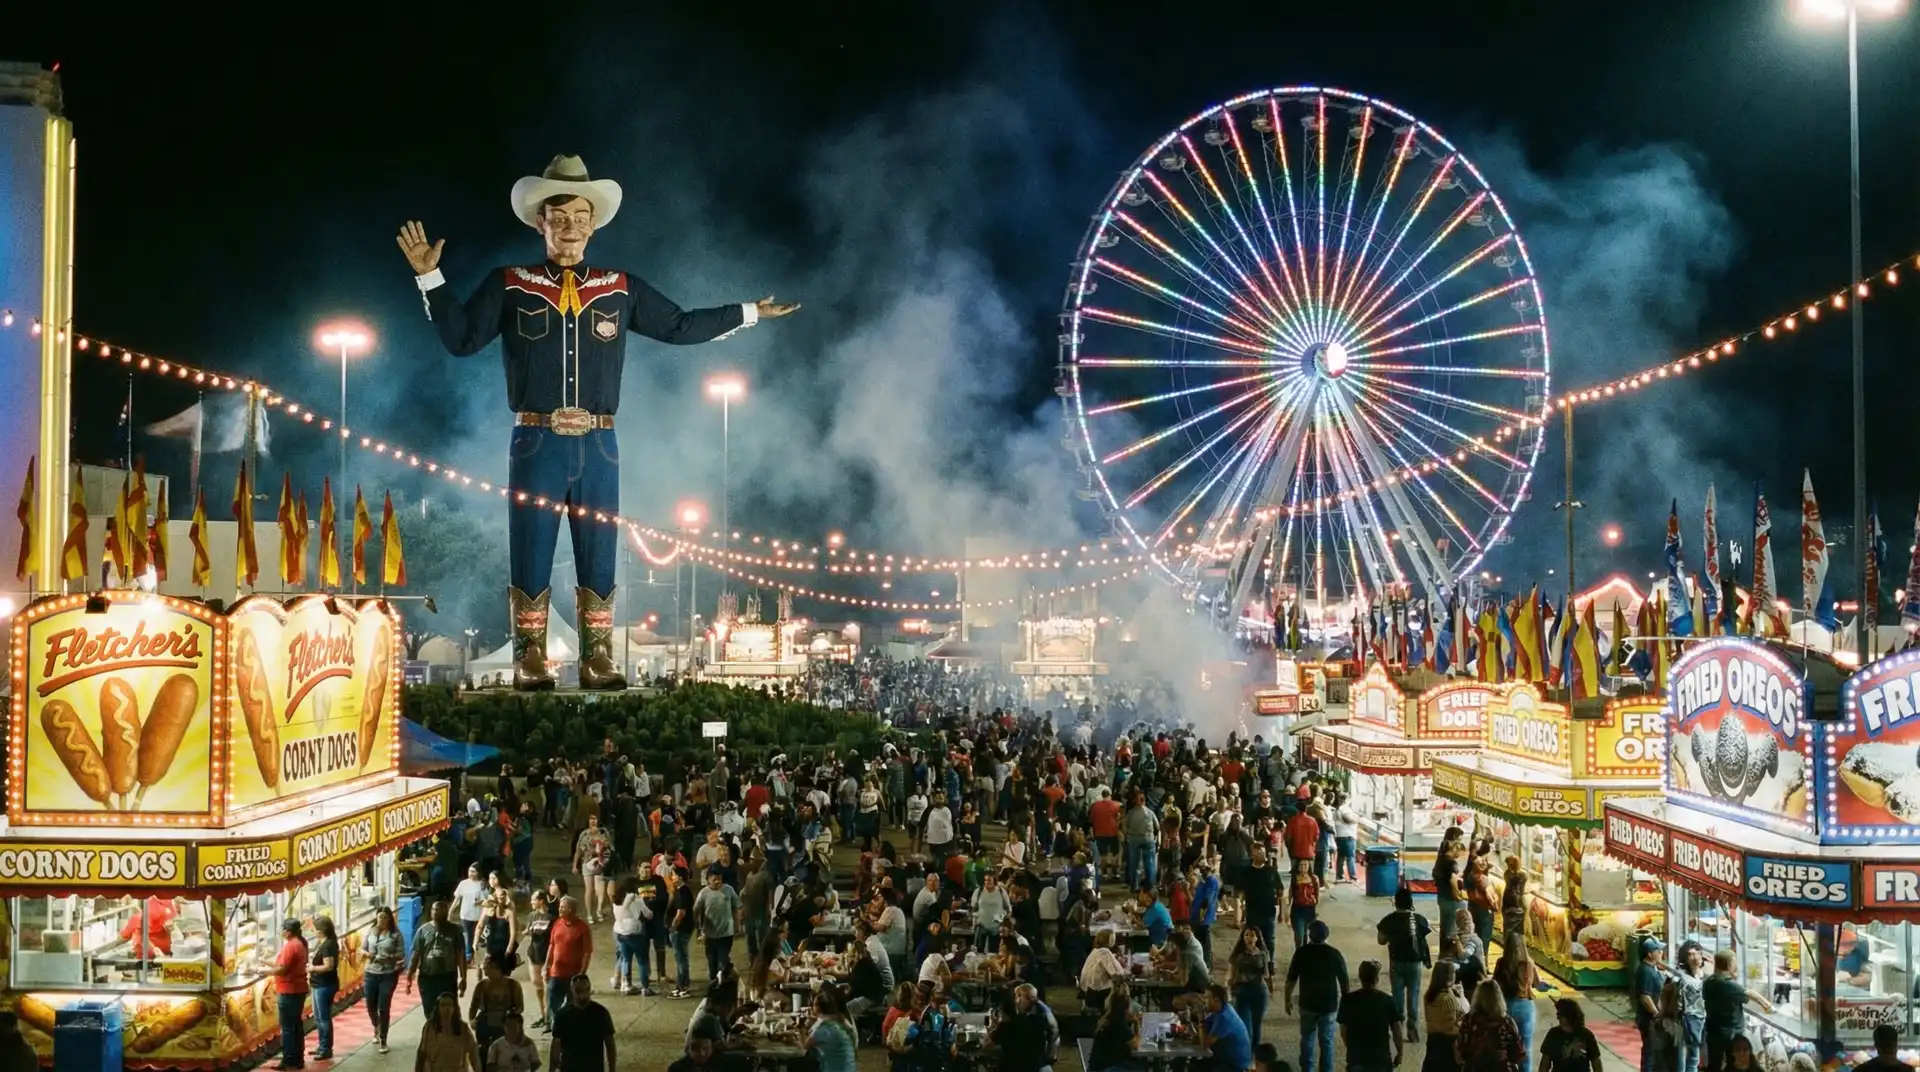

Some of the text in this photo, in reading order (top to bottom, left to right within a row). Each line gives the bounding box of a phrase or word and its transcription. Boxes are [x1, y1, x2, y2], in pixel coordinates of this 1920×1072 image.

[43, 620, 203, 678] Fletcher's
[286, 621, 355, 699] Fletcher's
[1675, 656, 1797, 739] FRIED OREOS
[1493, 712, 1559, 755] FRIED OREOS
[1622, 712, 1667, 735] FR
[283, 731, 357, 782] CORNY DOGS
[1615, 736, 1667, 762] OR
[383, 795, 443, 834] CORNY DOGS
[1519, 797, 1583, 816] OREOS
[298, 818, 372, 867] CORNY DOGS
[1609, 814, 1665, 859] FRIED OREOS
[0, 850, 177, 880] CORNY DOGS
[204, 859, 287, 882] CORNY DOGS
[226, 846, 271, 864] FRIED
[1673, 840, 1741, 887] FRIED OREOS
[1763, 862, 1826, 882] FRIED
[1748, 875, 1848, 902] OREOS
[1875, 871, 1920, 901] FR
